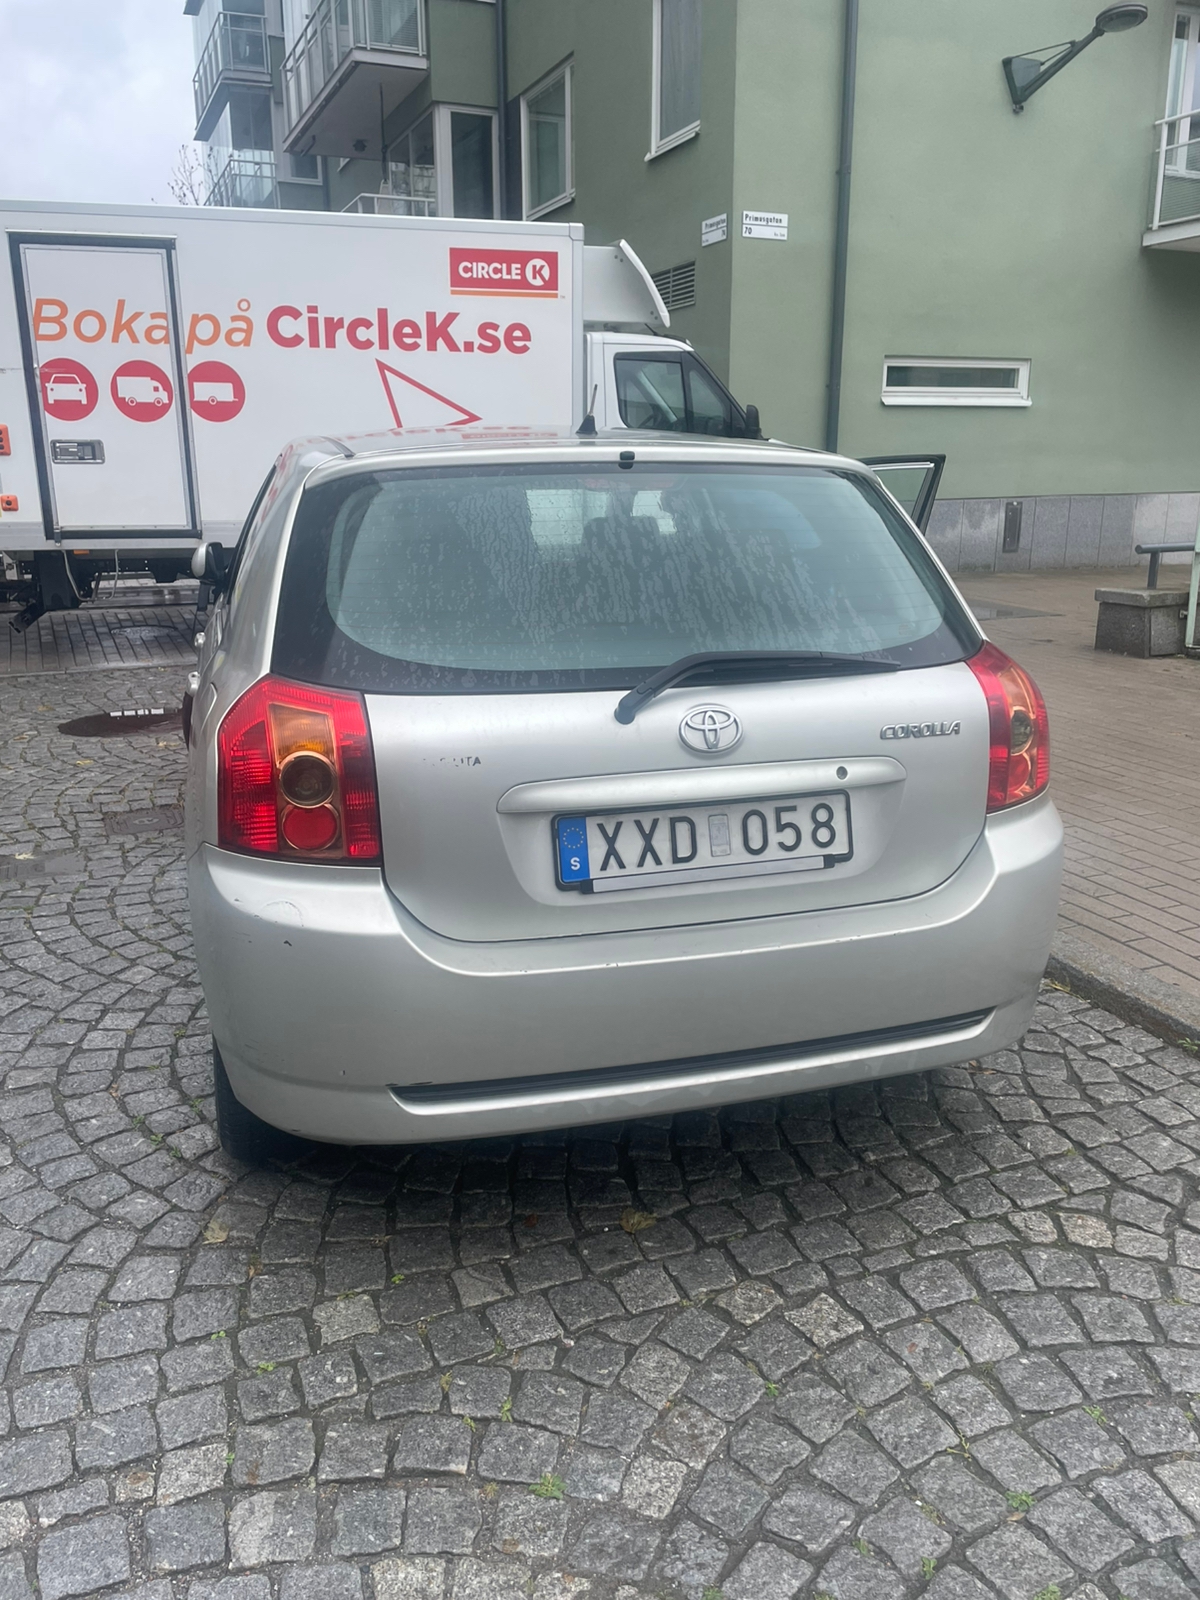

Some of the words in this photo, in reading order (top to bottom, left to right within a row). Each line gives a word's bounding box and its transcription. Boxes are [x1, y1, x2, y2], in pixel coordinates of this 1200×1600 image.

[745, 214, 782, 224] Primusgatan
[744, 227, 752, 235] 70
[458, 261, 522, 280] CIRCLE
[531, 264, 549, 284] K
[33, 298, 170, 344] Boka
[185, 299, 254, 355] på
[266, 305, 533, 355] CircleK.se
[880, 720, 961, 740] COROLLA
[596, 815, 698, 871] XXD
[742, 803, 836, 856] 058
[570, 857, 581, 871] S
